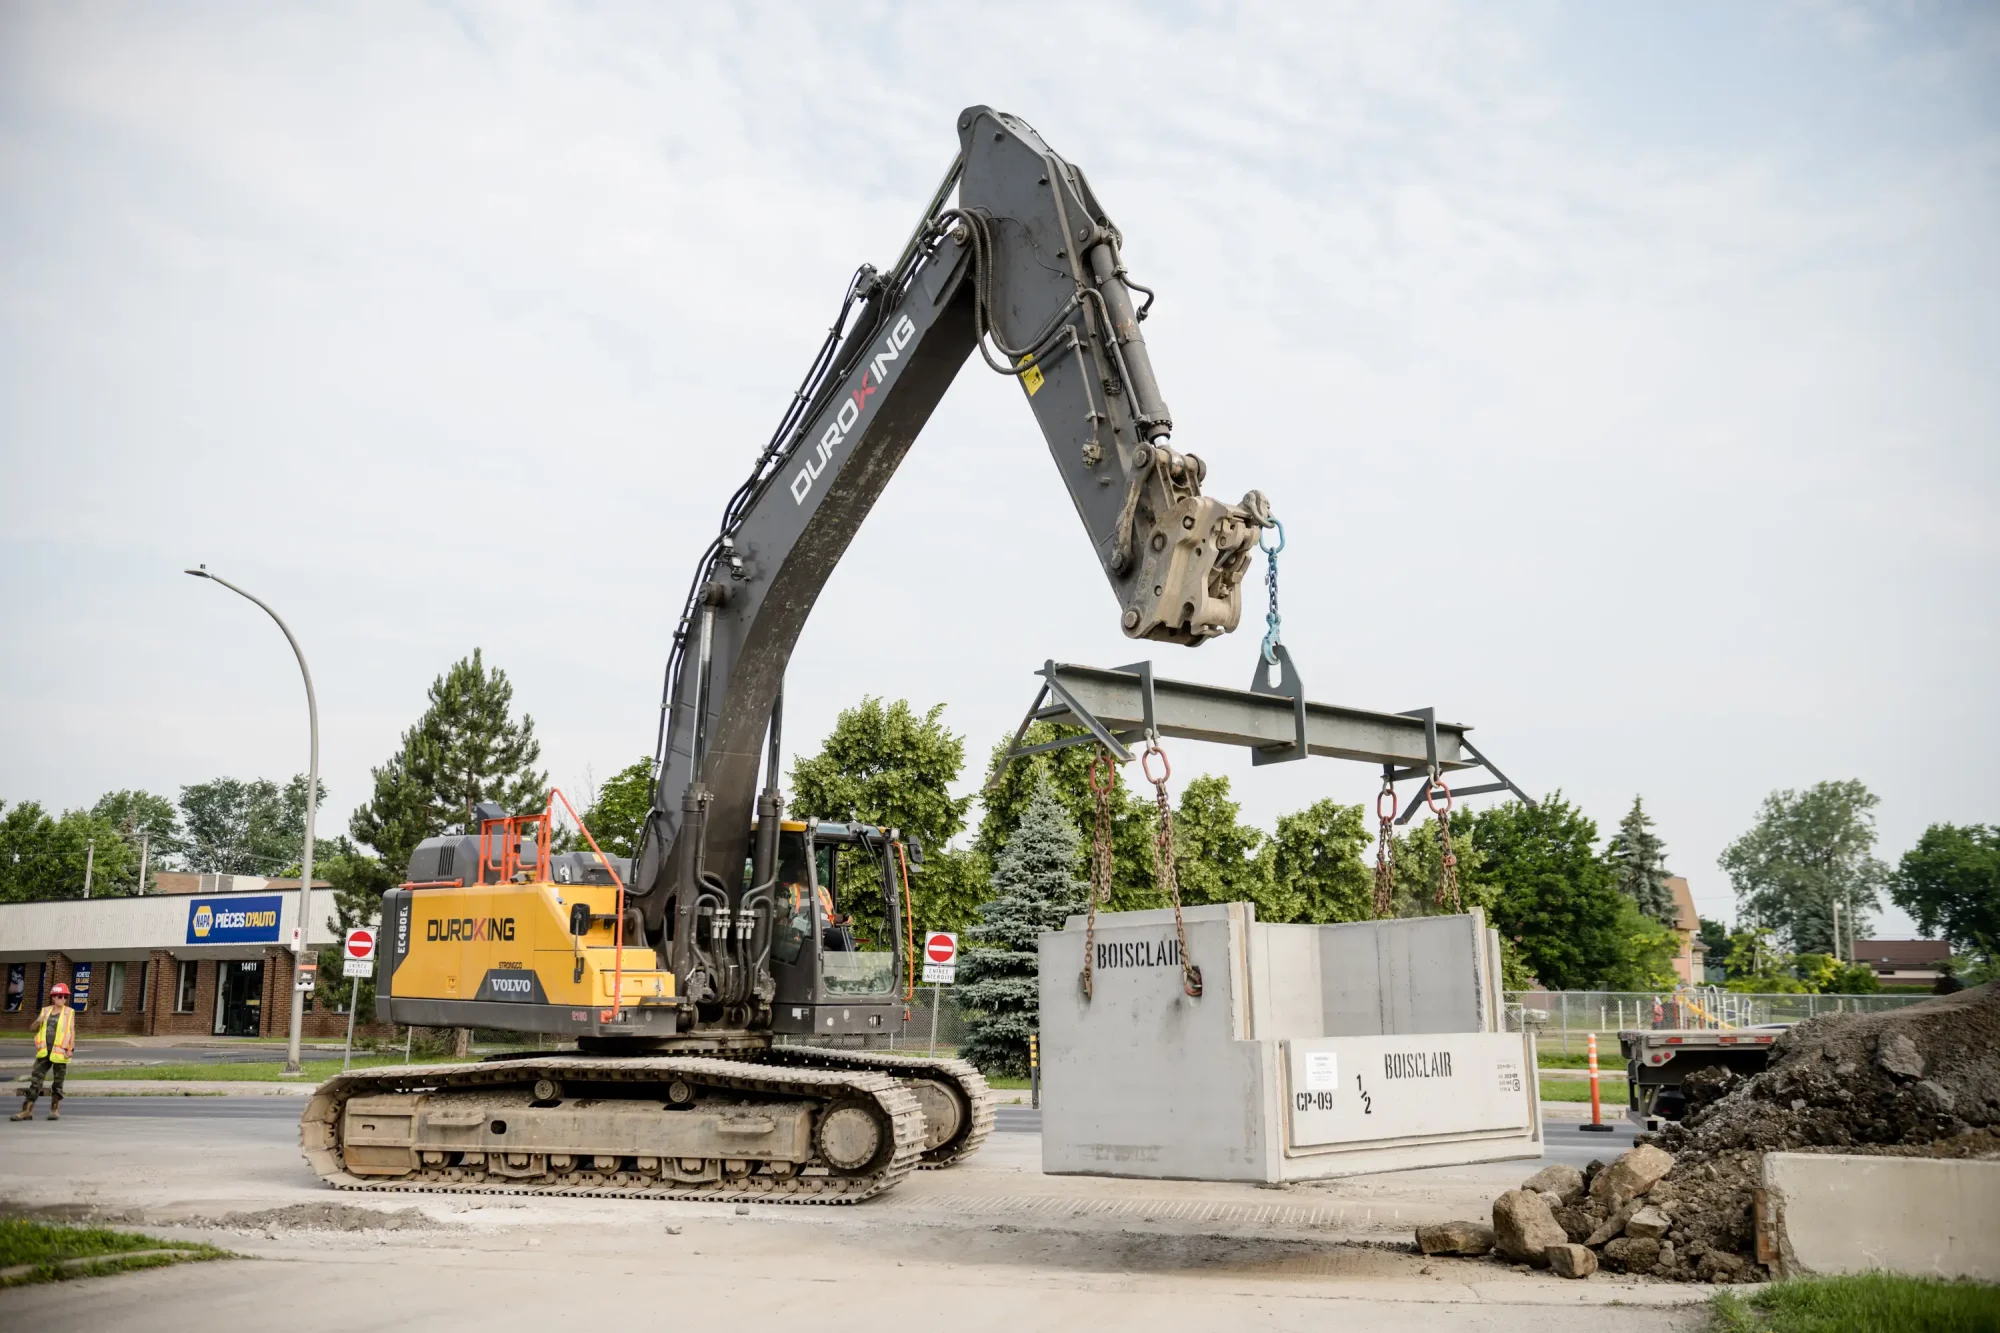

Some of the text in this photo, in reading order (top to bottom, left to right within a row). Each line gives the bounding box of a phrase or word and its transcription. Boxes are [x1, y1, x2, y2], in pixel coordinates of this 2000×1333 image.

[790, 314, 916, 506] DUROKING
[195, 914, 210, 928] NAPA
[215, 909, 276, 929] PIÈCES D'AUTO
[427, 918, 515, 941] DUROKING
[241, 962, 257, 971] 14411
[491, 978, 531, 992] VOLVO
[1384, 1052, 1452, 1079] BOISCLAIR
[1296, 1092, 1333, 1111] CP-09
